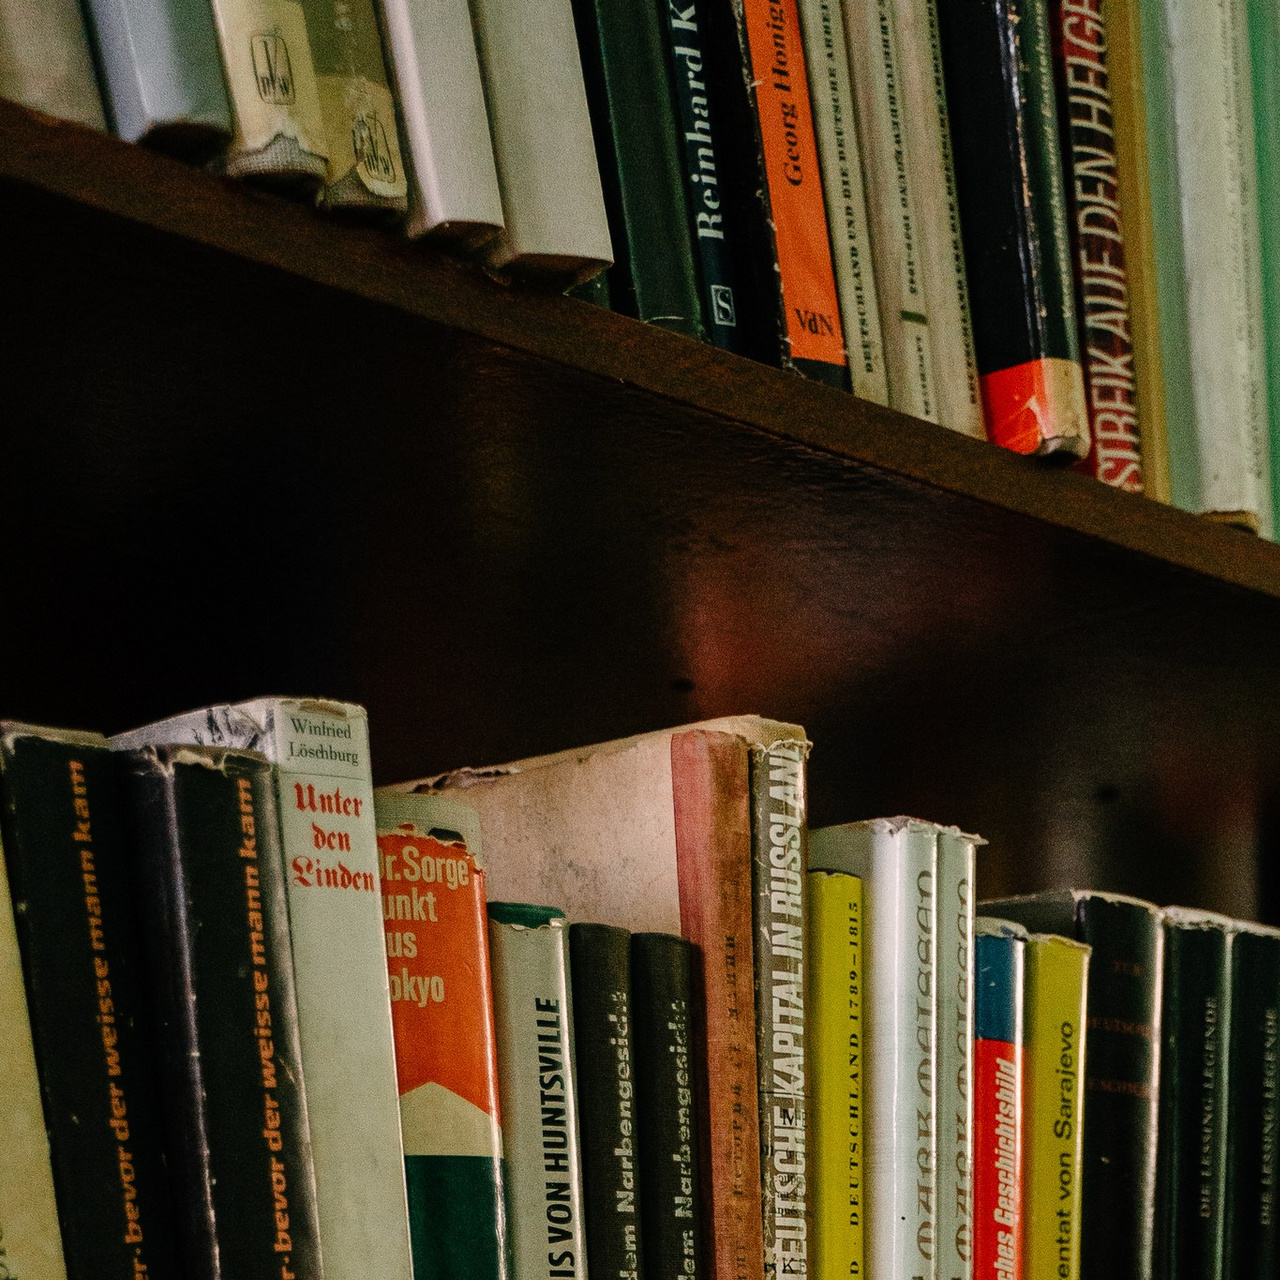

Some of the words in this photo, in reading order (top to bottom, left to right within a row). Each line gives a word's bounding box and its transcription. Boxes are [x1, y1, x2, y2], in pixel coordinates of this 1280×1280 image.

[674, 46, 725, 241] Reinhard
[778, 102, 803, 187] Georg
[843, 206, 857, 240] UND
[794, 308, 834, 337] VdN
[850, 247, 873, 373] DEUTSCHLAND
[288, 741, 360, 766] Löschburg
[290, 716, 352, 742] Winfried
[68, 759, 94, 843] kam
[236, 777, 259, 859] kam
[292, 781, 364, 819] Unter
[310, 821, 352, 853] den
[79, 849, 106, 951] mann
[290, 853, 376, 893] Linden
[382, 886, 440, 923] unkt
[401, 845, 470, 891] Sorge
[241, 864, 266, 967] mann
[770, 921, 804, 960] IN
[92, 954, 124, 1077] weisse
[250, 970, 276, 1088] weisse
[771, 962, 807, 1098] KAPITAL
[1201, 995, 1218, 1090] LEGENDE
[1262, 1006, 1278, 1100] LEGENDE
[108, 1082, 130, 1142] der
[260, 1092, 283, 1152] der
[535, 996, 570, 1174] HUNTSVILLE
[607, 990, 636, 1213] Narbengesicht
[667, 998, 694, 1219] Narbengesicht
[1053, 1021, 1077, 1141] Sarajevo
[848, 1032, 861, 1227] DEUTSCHLAND
[993, 1057, 1017, 1228] Geschichtsbild
[1200, 1098, 1215, 1178] LESSING
[1260, 1106, 1276, 1186] LESSING
[116, 1144, 144, 1244] bevor
[267, 1157, 293, 1252] bevor
[545, 1181, 575, 1245] VON
[1056, 1153, 1073, 1200] von
[1200, 1185, 1213, 1219] DIE
[1259, 1195, 1272, 1226] DIE
